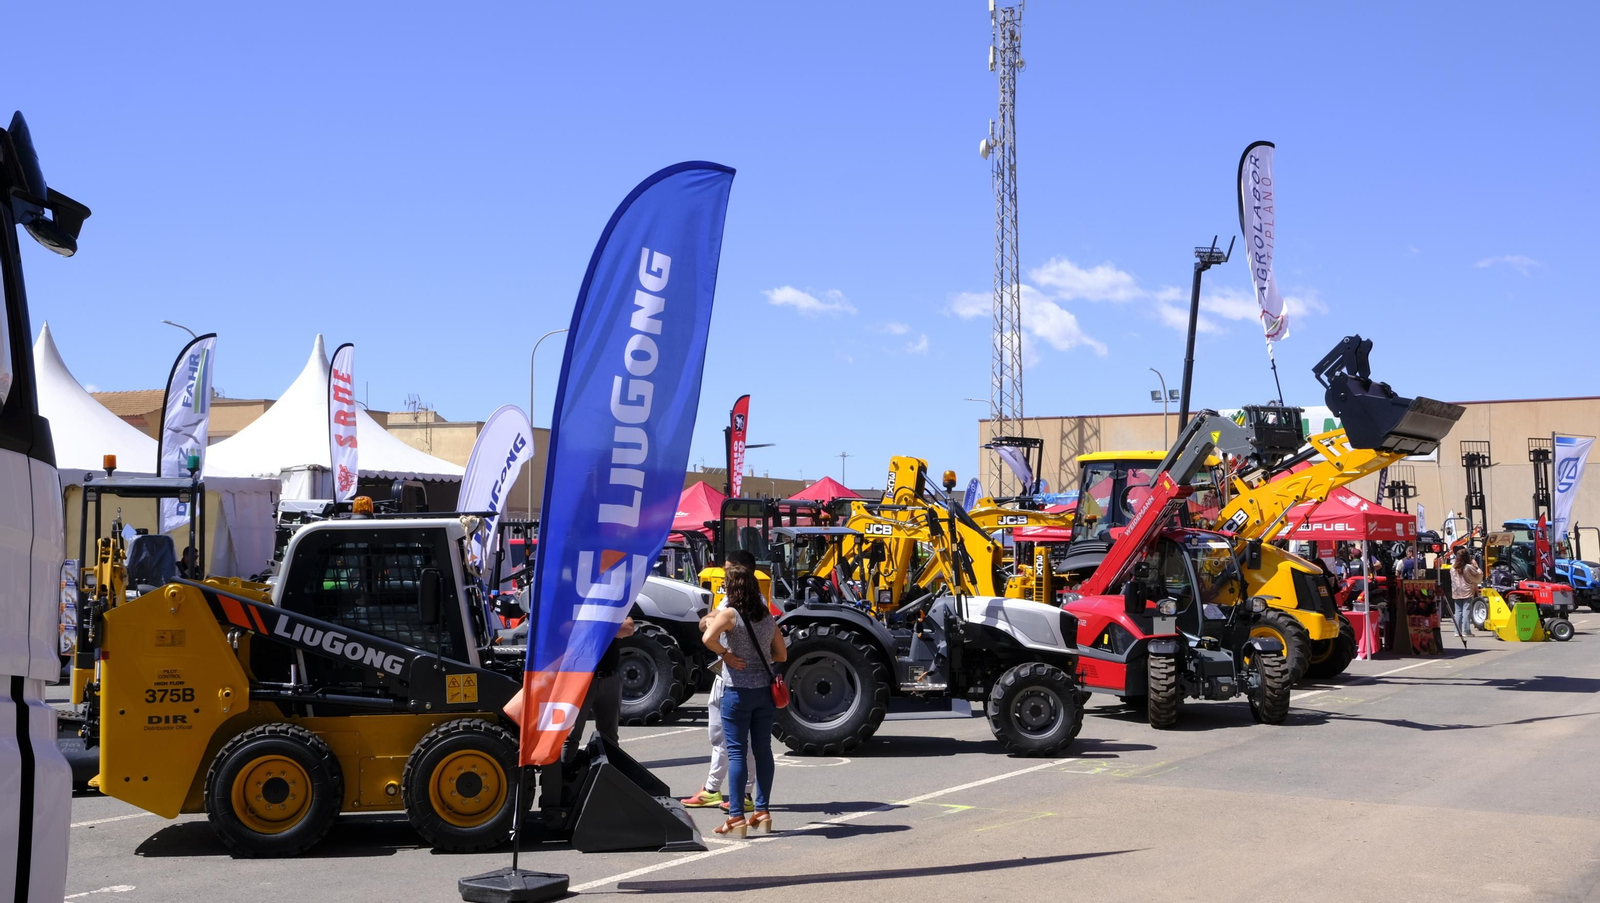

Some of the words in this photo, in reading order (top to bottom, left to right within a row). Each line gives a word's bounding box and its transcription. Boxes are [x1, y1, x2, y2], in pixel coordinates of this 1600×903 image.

[1249, 154, 1268, 300] AGROLABOR
[1261, 176, 1274, 283] TIPLANO
[182, 353, 200, 409] FAHR
[887, 471, 896, 494] 3CX
[998, 515, 1028, 525] JCB
[1124, 495, 1154, 536] WEIDEMANN
[1219, 509, 1248, 532] CB
[865, 524, 893, 535] JCB
[1312, 523, 1356, 532] FUEL
[1036, 554, 1044, 576] 3CX
[144, 688, 195, 704] 375B
[147, 715, 188, 725] DIR
